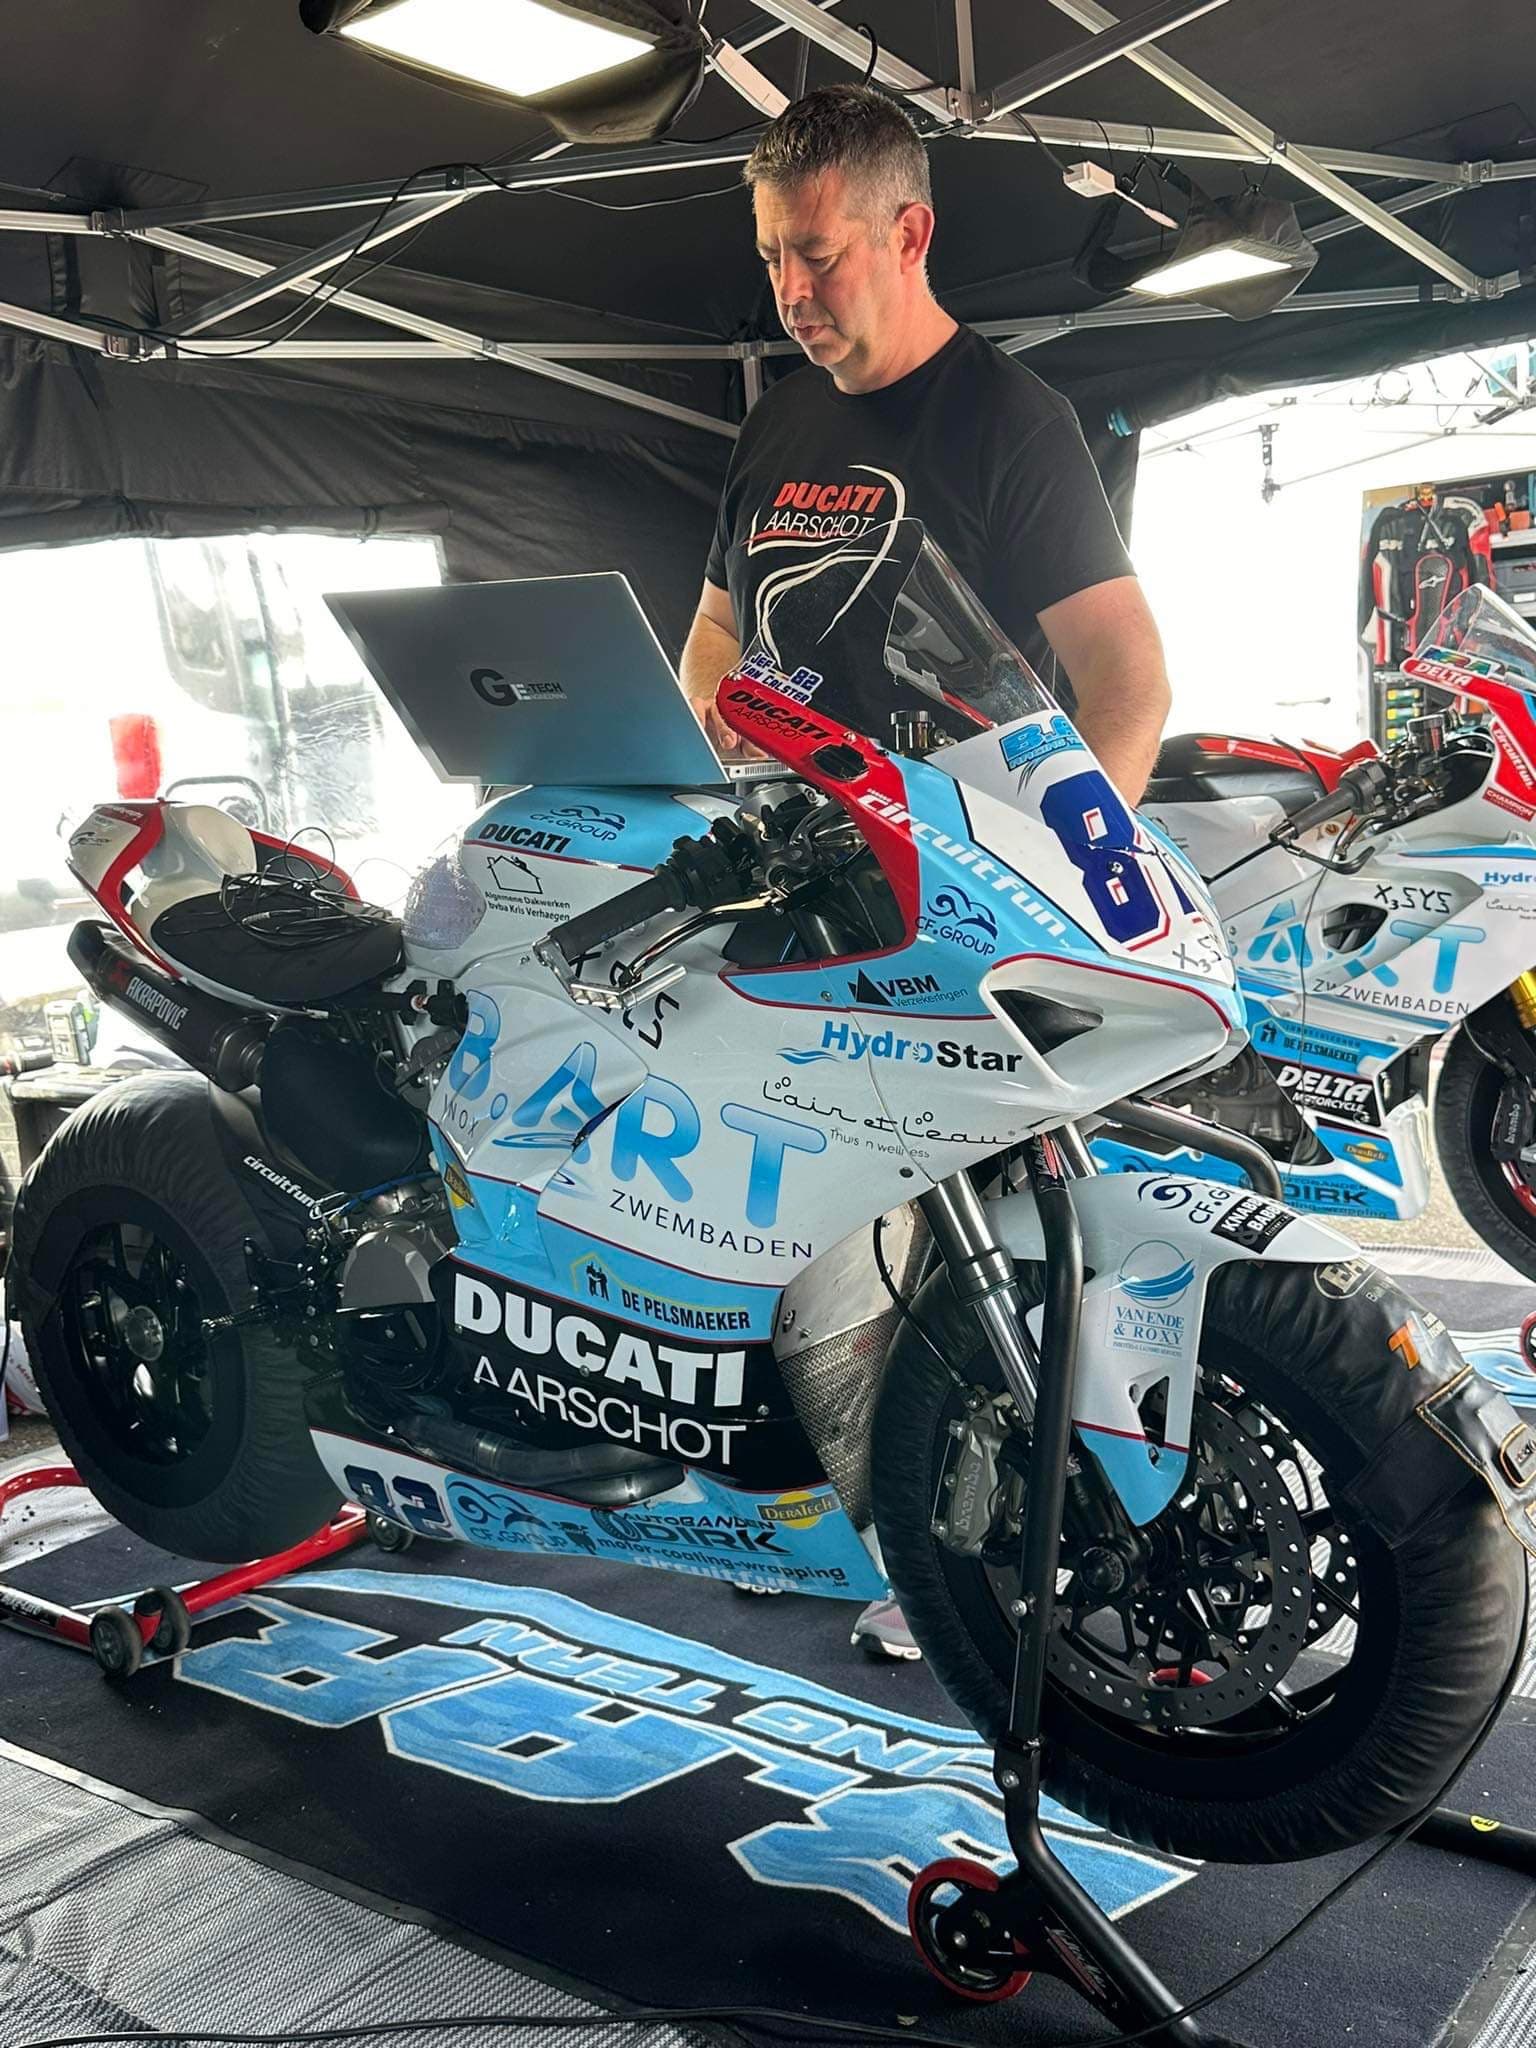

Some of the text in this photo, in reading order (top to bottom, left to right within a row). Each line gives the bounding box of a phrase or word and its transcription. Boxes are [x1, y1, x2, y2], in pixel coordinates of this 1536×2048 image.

[772, 481, 887, 513] DUCATI
[763, 510, 875, 538] AARSCHOT
[750, 652, 774, 669] JEF
[1413, 663, 1474, 687] DELTA
[741, 662, 811, 704] VAN CALSTER
[790, 667, 821, 691] 82
[726, 689, 833, 740] DUCATI
[731, 706, 803, 740] AARSCHOT
[478, 823, 571, 853] DUCATI
[856, 788, 1067, 937] circuitfun
[1484, 872, 1536, 885] Hydr
[484, 890, 571, 909] Algemene Dakwerken
[510, 904, 525, 915] Kris
[527, 907, 570, 923] Verhaegen
[877, 973, 941, 997] VBM
[1338, 985, 1471, 1015] ZWEMBADEN
[820, 1019, 1023, 1073] HydroStar
[1276, 1065, 1373, 1103] DELTA
[863, 1115, 898, 1133] et
[1503, 1102, 1521, 1145] brembo
[242, 1154, 322, 1208] circuitfun
[1283, 1184, 1372, 1207] DIRK
[609, 1188, 814, 1259] ZWEMBADEN
[620, 1288, 751, 1331] DE PELSMAEKER
[1116, 1305, 1185, 1329] VAN ENDE
[454, 1273, 746, 1408] DUCATI
[1113, 1322, 1185, 1345] & ROXY
[472, 1355, 747, 1465] AARSCHOT
[955, 1461, 982, 1532] brembo
[623, 1512, 776, 1531] AUTOBANDEN
[634, 1521, 793, 1554] DIRK
[597, 1536, 846, 1581] motor-coating-wrapping
[633, 1554, 800, 1590] circuitfun
[442, 1617, 730, 1716] TEAM
